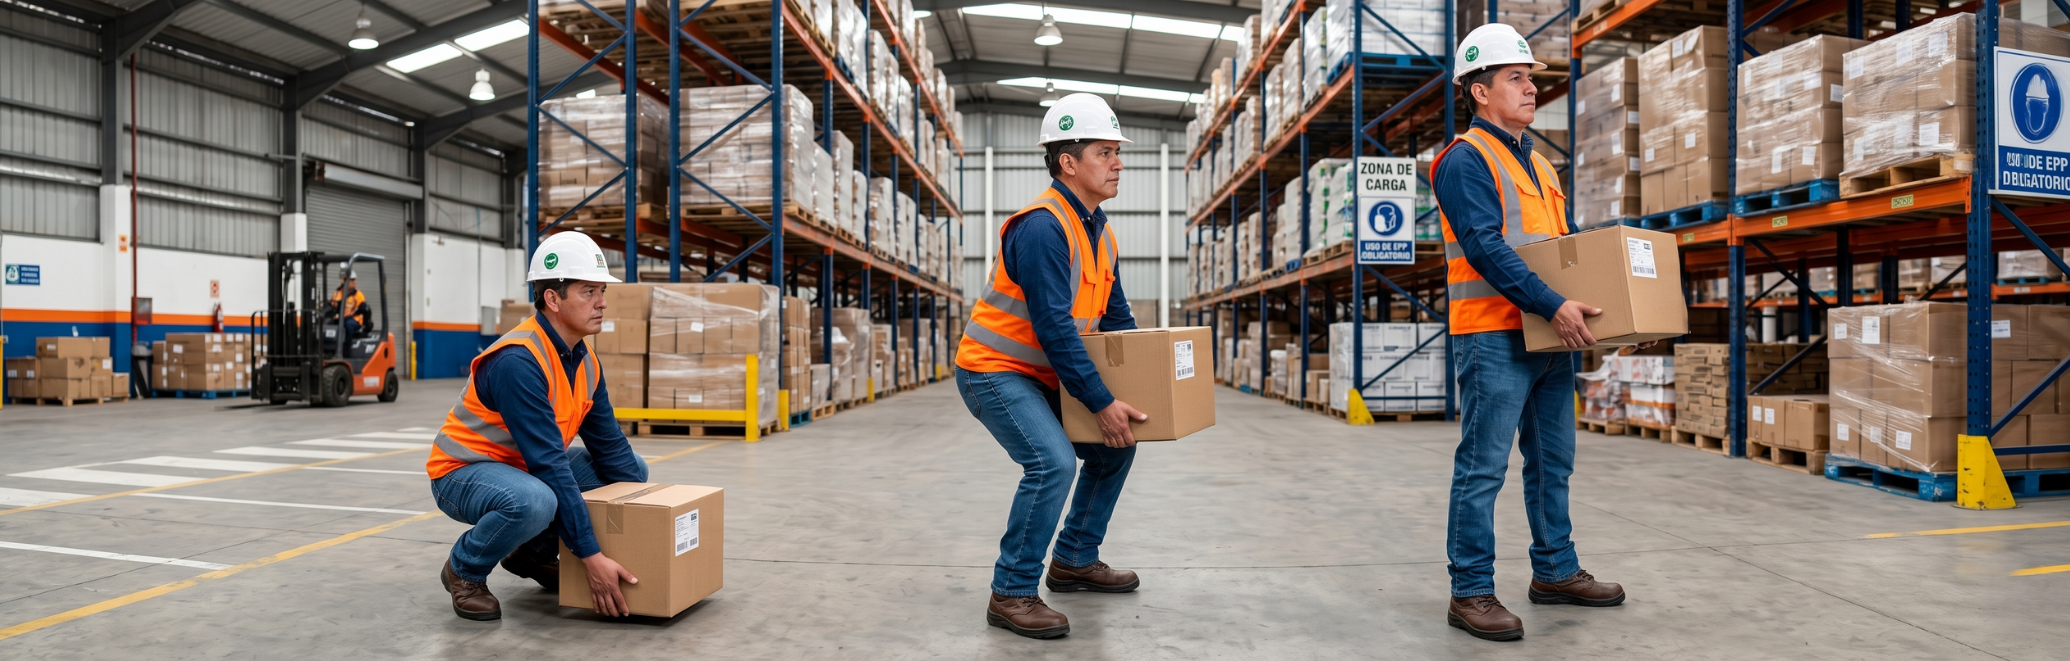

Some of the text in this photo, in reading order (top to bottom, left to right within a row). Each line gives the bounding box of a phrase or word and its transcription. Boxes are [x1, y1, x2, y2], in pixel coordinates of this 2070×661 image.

[1360, 162, 1413, 176] ZONA DE
[2028, 154, 2044, 170] DE
[2045, 155, 2069, 172] EPP
[1366, 178, 1407, 191] CARGA
[1365, 242, 1409, 251] USO DE EPP
[1361, 251, 1411, 260] OBLIGATORIO
